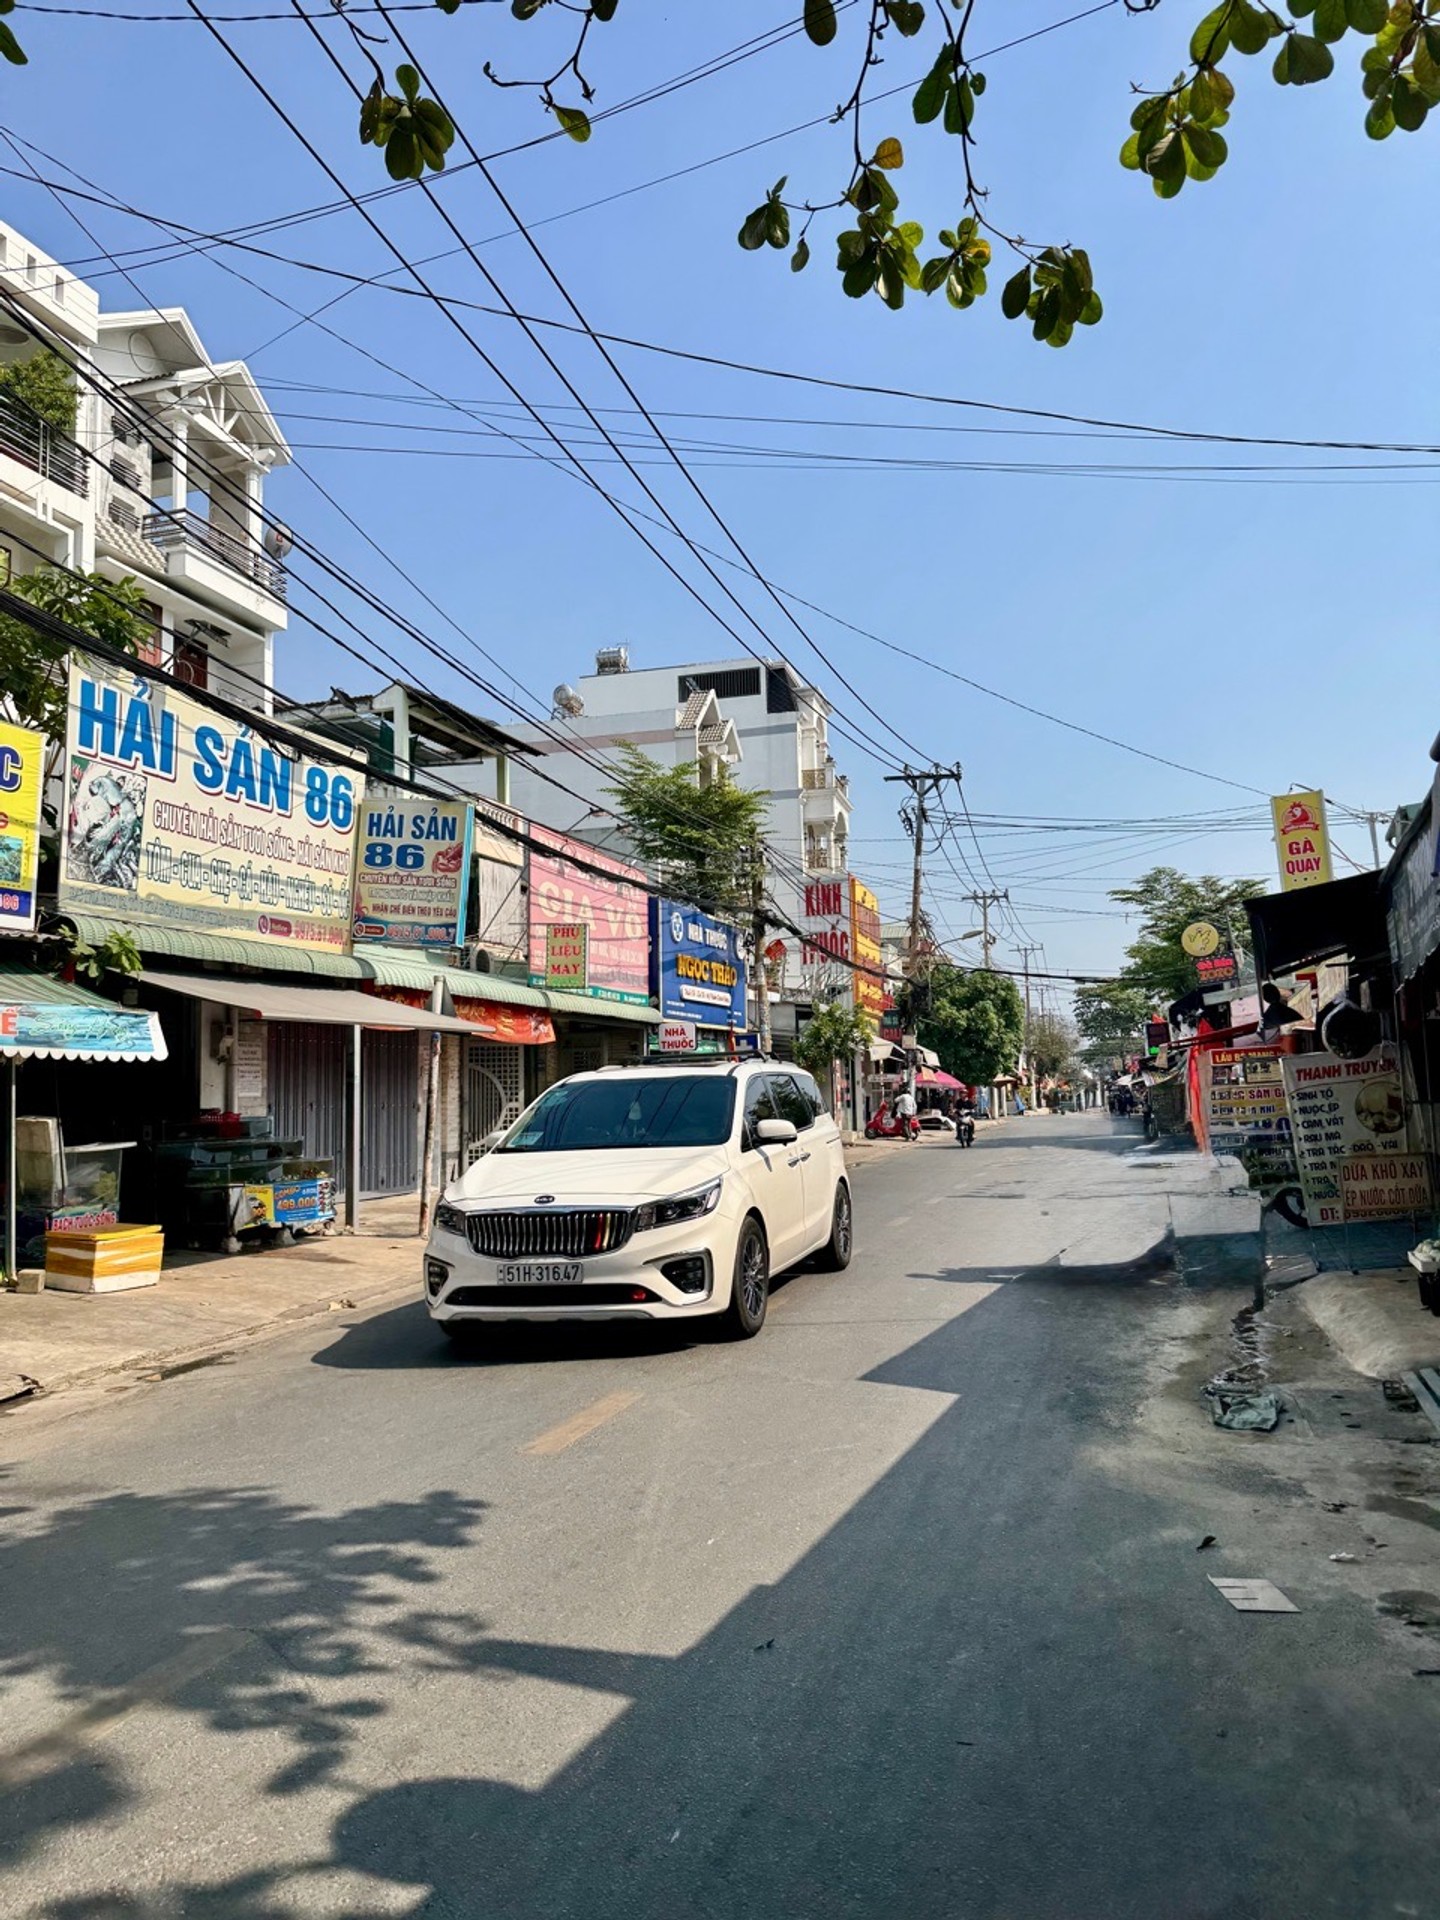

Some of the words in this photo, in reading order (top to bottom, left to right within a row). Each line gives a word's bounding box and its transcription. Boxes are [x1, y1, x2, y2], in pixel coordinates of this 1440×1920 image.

[78, 676, 177, 780] HẢI
[192, 720, 293, 818] SẢN
[304, 765, 355, 833] 86
[153, 799, 199, 839] CHUYÊN
[199, 807, 219, 844] HẢI
[220, 813, 242, 850] SẢN
[367, 806, 404, 838] HẢI
[411, 807, 457, 841] SẢN
[1288, 836, 1315, 855] GÀ
[364, 842, 425, 871] 86
[1286, 857, 1321, 875] QUAY
[146, 836, 172, 884] TÔM
[181, 851, 202, 892] CUA
[211, 858, 231, 904] GHẸ
[538, 881, 597, 931] GIA
[805, 877, 842, 916] KÍNH
[553, 927, 580, 942] PHỤ
[550, 944, 582, 957] LIỆU
[550, 963, 580, 975] MAY
[677, 953, 710, 985] NGỌC
[710, 960, 738, 987] THẢO
[664, 1025, 686, 1036] NHÀ
[661, 1036, 694, 1049] THUỐC
[1296, 1064, 1341, 1082] THANH
[1296, 1090, 1318, 1101] SINH
[1372, 1159, 1397, 1180] KHÔ
[1400, 1161, 1424, 1179] XAY
[1360, 1186, 1385, 1206] NƯỚC
